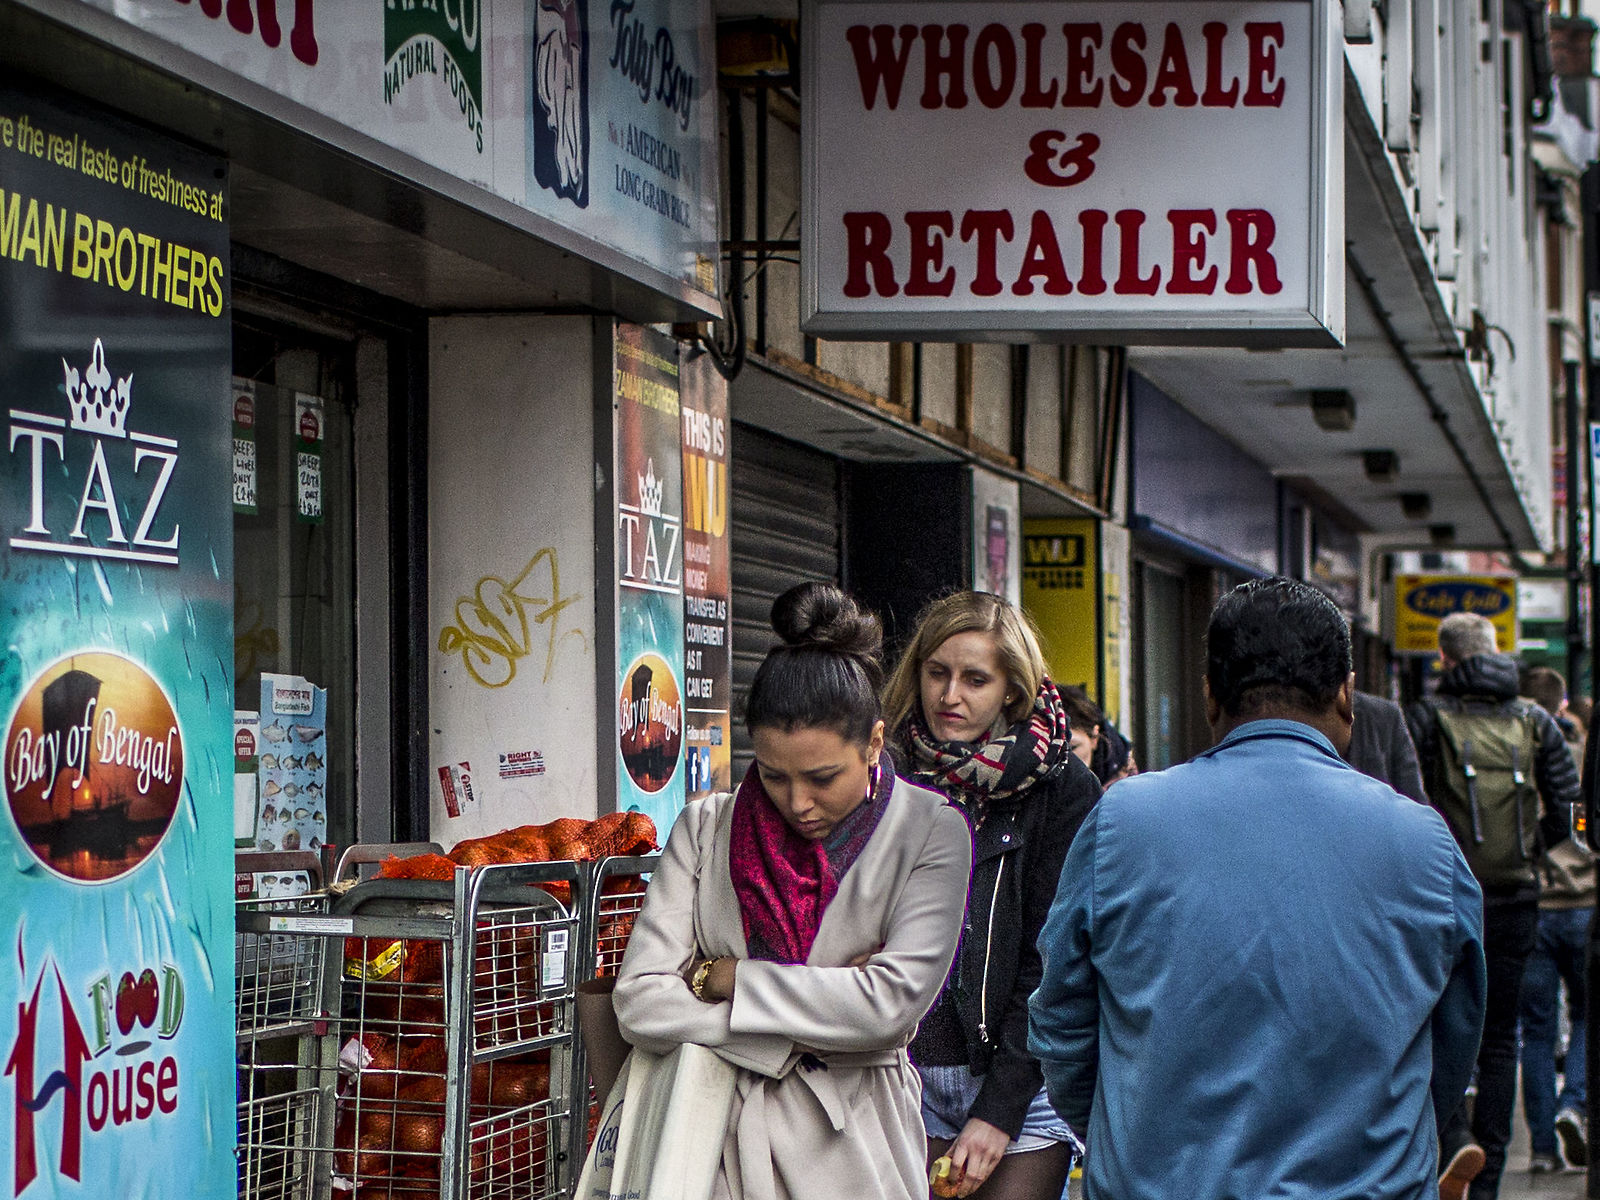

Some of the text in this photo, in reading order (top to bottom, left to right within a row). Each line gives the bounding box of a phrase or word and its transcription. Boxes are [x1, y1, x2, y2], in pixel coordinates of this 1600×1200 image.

[384, 41, 483, 154] NATURAL FOODS
[609, 0, 693, 132] Tolly Boy
[846, 21, 1286, 111] WHOLESALE
[17, 115, 44, 158] the
[47, 133, 78, 170] real
[81, 140, 118, 184] taste
[121, 155, 138, 190] of
[139, 158, 207, 216] freshness
[210, 190, 224, 222] at
[627, 123, 681, 181] AMERICAN
[1024, 130, 1101, 187] &
[615, 164, 641, 202] LONG
[642, 180, 670, 219] GRAIN
[71, 213, 224, 318] BROTHERS
[842, 208, 1284, 298] RETAILER
[683, 406, 725, 457] THIS IS
[10, 425, 179, 549] TAZ
[619, 514, 681, 584] TAZ
[685, 568, 708, 590] MONEY
[686, 595, 726, 620] TRANSFER AS
[686, 623, 724, 646] CONVENIENT
[686, 651, 702, 671] AS IT
[686, 677, 713, 699] CAN GET
[620, 681, 681, 742] Bay of Bengal
[10, 697, 177, 800] Bay of Bengal
[88, 962, 184, 1058] FOOD
